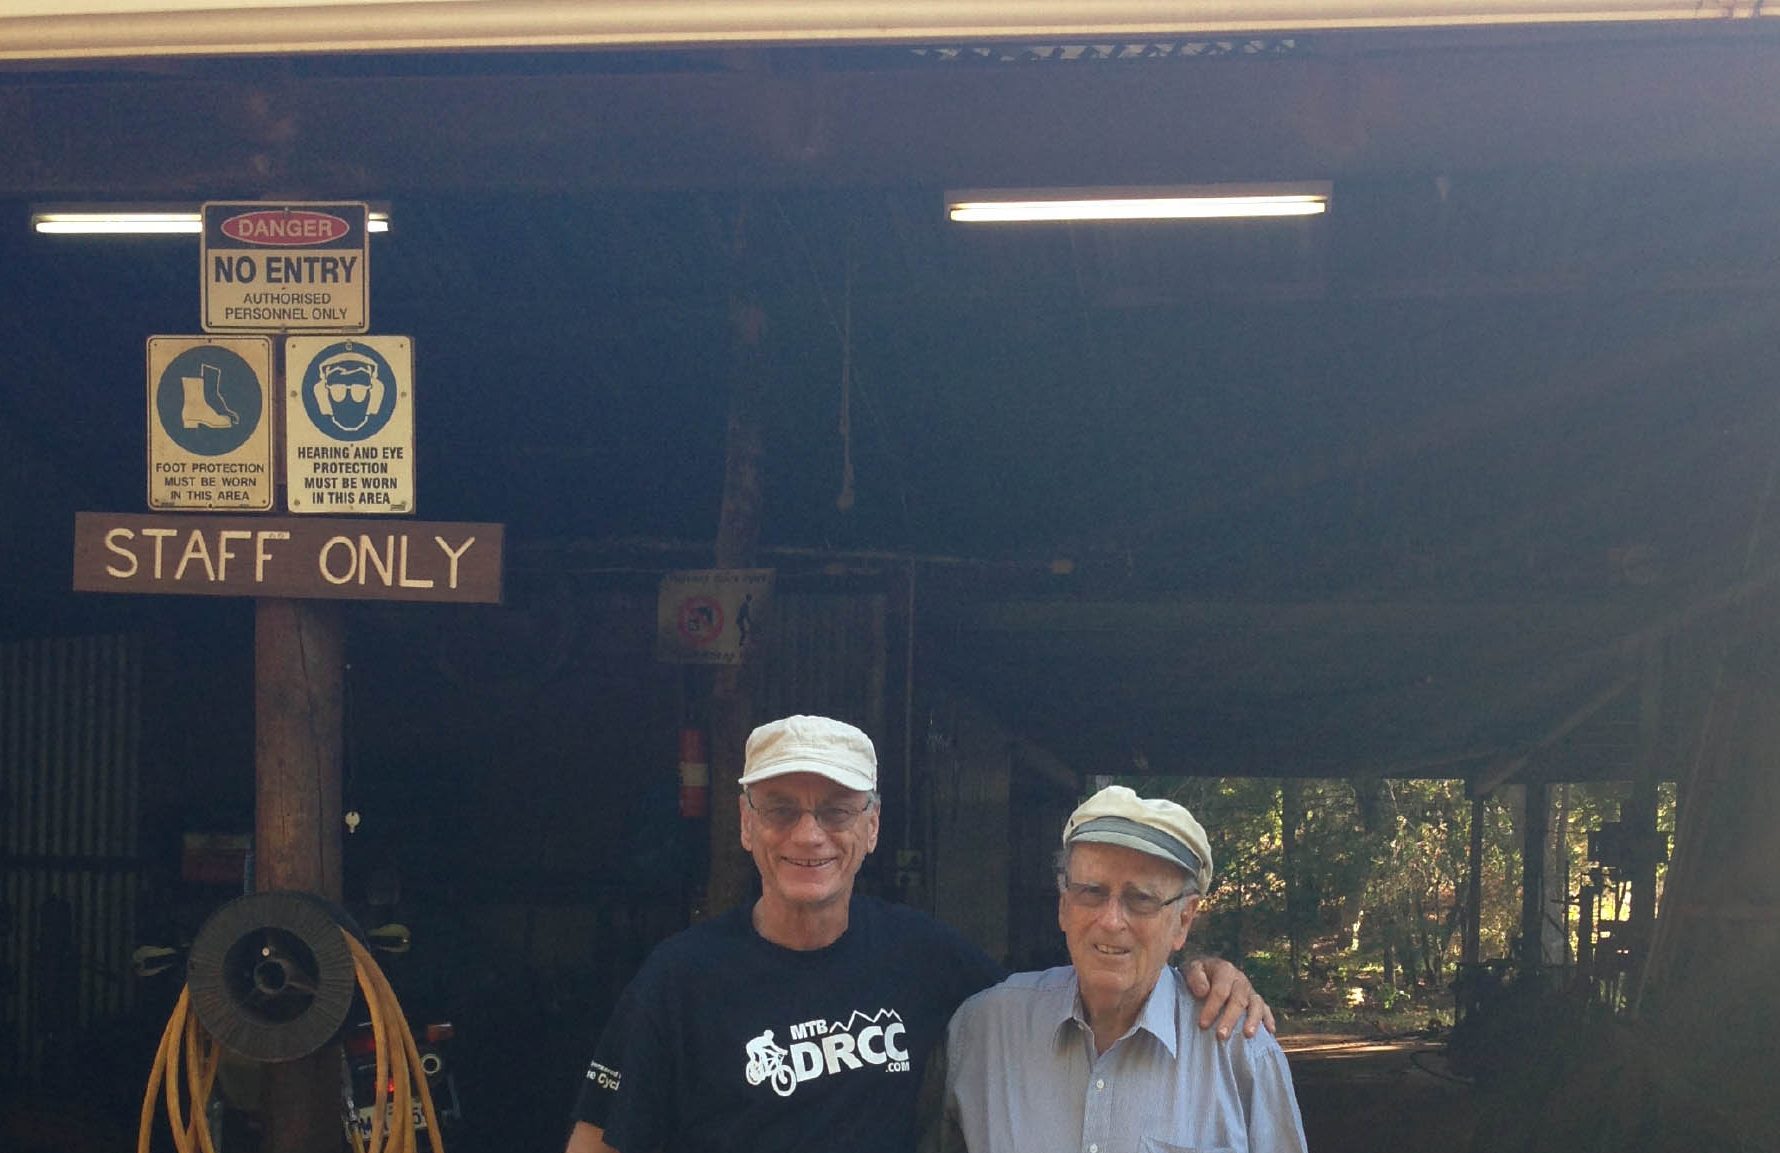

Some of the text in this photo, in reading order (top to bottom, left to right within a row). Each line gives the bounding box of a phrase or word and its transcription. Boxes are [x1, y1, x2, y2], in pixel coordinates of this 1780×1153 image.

[238, 219, 333, 237] DANGER
[214, 256, 358, 284] NO ENTRY
[243, 293, 332, 305] AUTHORISED
[225, 307, 348, 320] PERSONNEL ONLY
[297, 447, 404, 459] HEARING AND EYE
[155, 462, 265, 473] FOOT PROTECTION
[313, 462, 388, 474] PROTECTION
[164, 477, 257, 487] MUST BE WORN
[304, 477, 398, 489] MUST BE WORN
[170, 490, 250, 501] IN THIS AREA
[312, 492, 391, 505] IN THIS AREA
[104, 527, 476, 589] STAFF ONLY
[790, 1019, 829, 1041] MTB
[790, 1022, 909, 1083] DRCC
